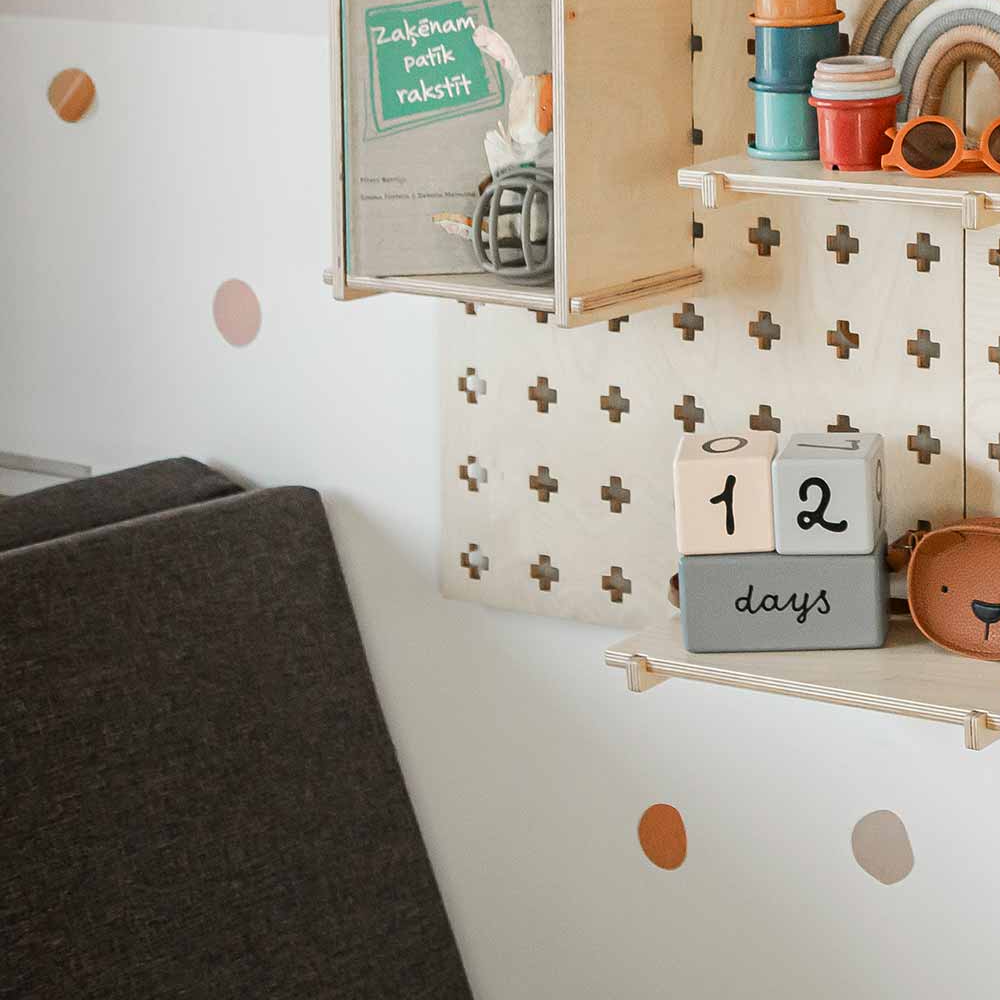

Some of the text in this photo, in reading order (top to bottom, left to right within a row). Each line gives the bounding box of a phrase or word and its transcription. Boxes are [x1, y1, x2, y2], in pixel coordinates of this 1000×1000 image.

[404, 44, 455, 72] patīk
[396, 73, 473, 105] rakstīt
[709, 474, 848, 536] 1 2
[734, 584, 831, 624] days
